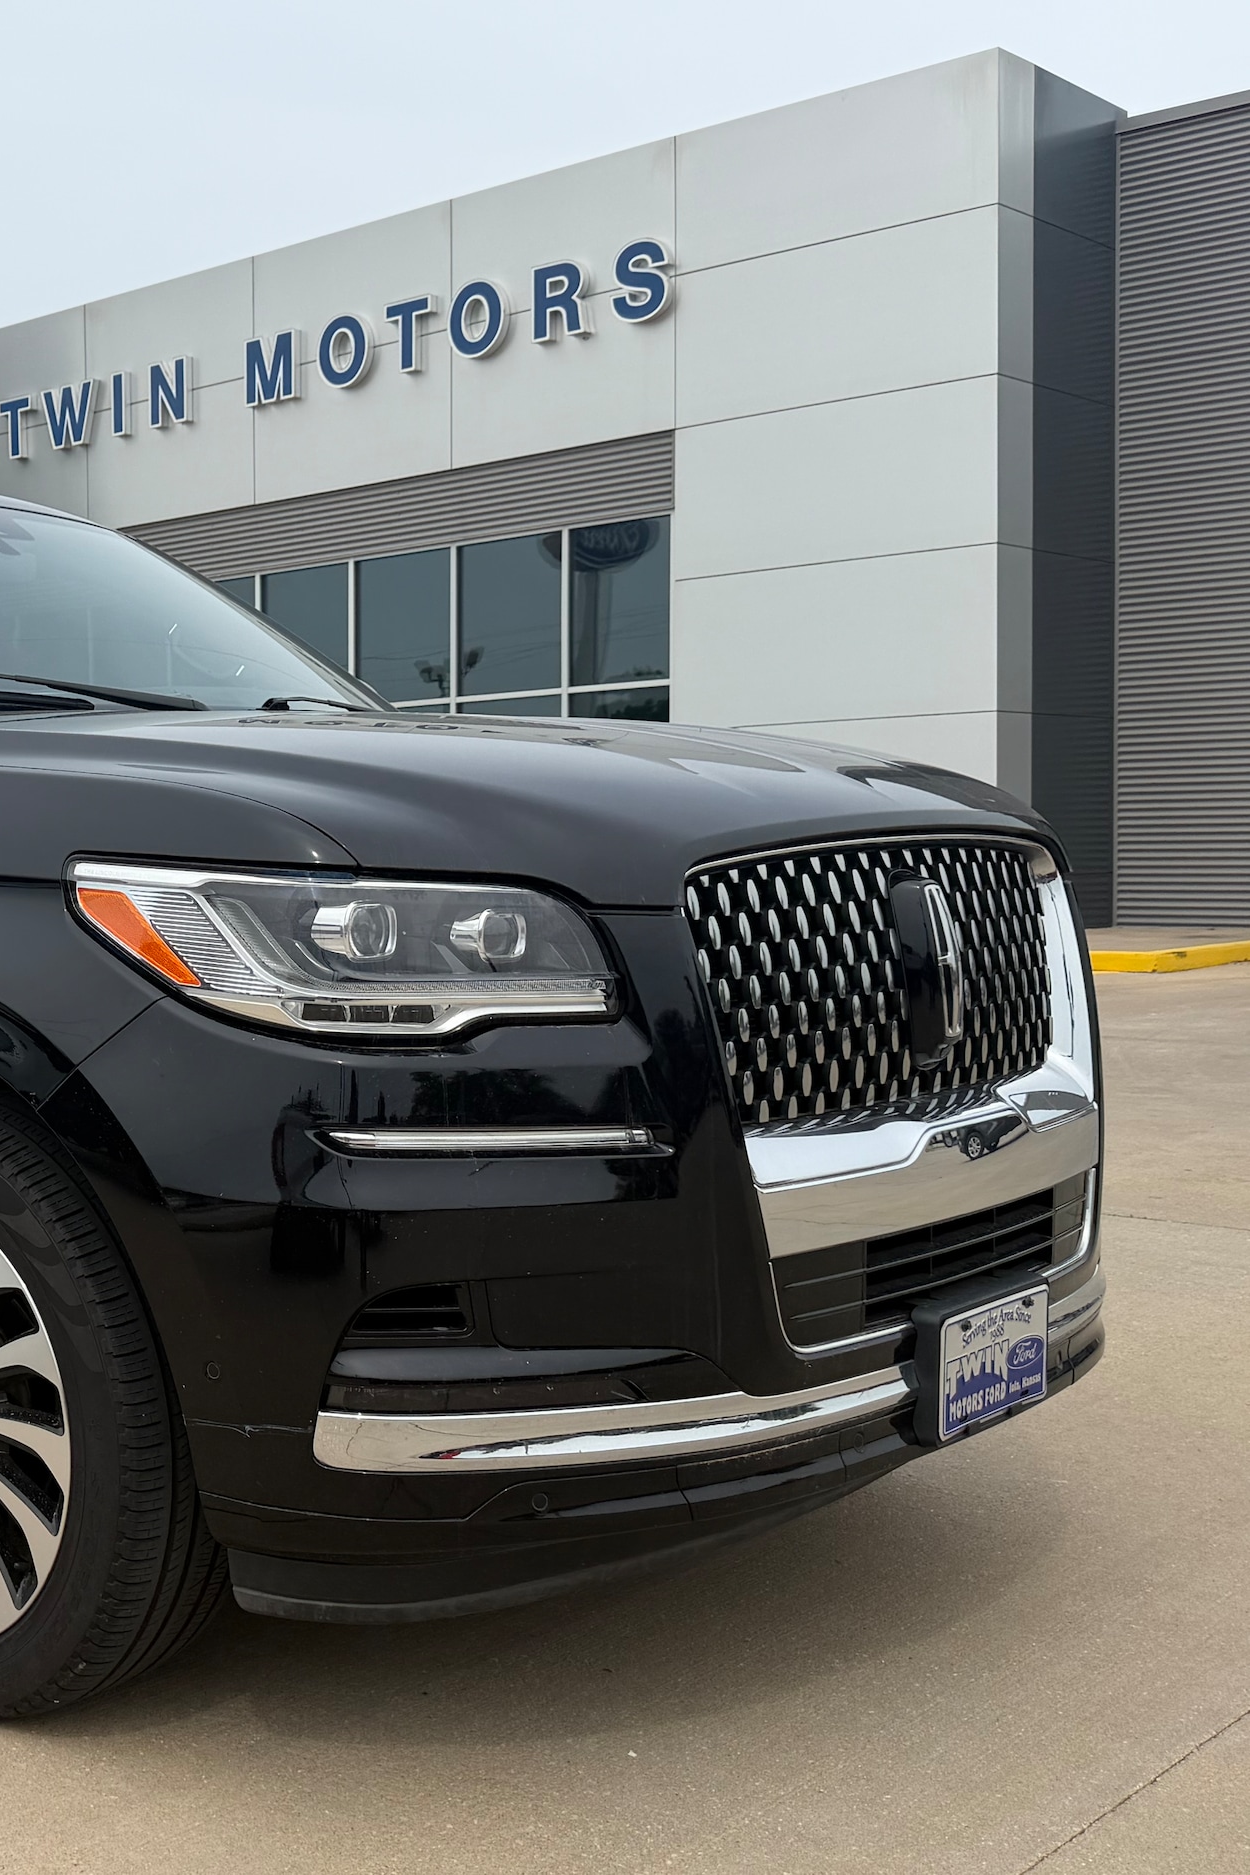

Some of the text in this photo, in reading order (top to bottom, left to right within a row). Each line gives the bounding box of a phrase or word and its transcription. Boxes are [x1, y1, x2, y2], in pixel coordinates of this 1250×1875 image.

[245, 237, 673, 408] MOTORS
[961, 1319, 987, 1349] Serving
[987, 1310, 998, 1328] the
[998, 1307, 1014, 1322] Area
[946, 1339, 1010, 1400] TWIN
[1013, 1341, 1038, 1365] Ford
[1022, 1372, 1042, 1388] Kansas
[949, 1381, 1007, 1422] MOTORS FORD
